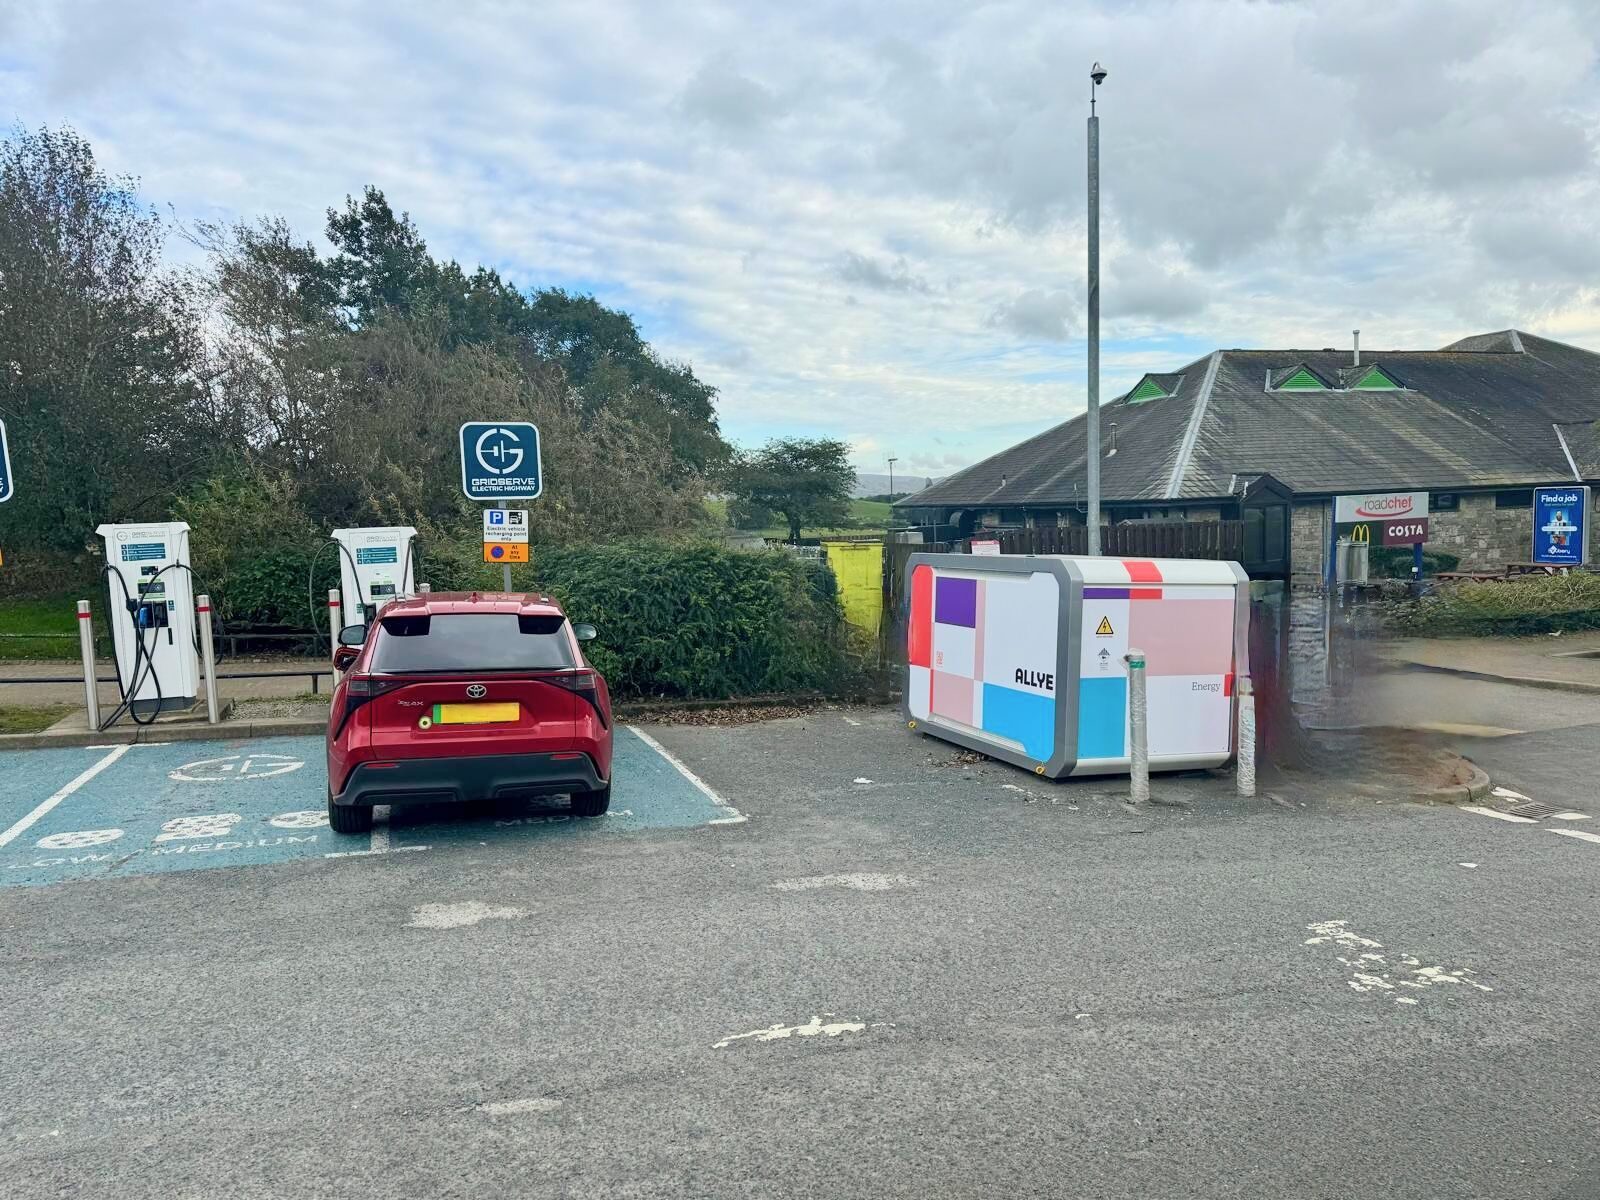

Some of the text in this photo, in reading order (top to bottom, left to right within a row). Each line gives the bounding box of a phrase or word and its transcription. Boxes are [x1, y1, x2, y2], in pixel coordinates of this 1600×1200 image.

[471, 477, 536, 486] GRIDSERVE
[1364, 496, 1413, 511] roadchef
[1541, 494, 1558, 503] Find
[1564, 494, 1578, 503] job
[492, 512, 502, 524] P
[1388, 524, 1424, 537] COSTA
[1015, 667, 1054, 691] ALLYE
[1191, 681, 1221, 692] Energy
[151, 834, 319, 856] MEDIUM
